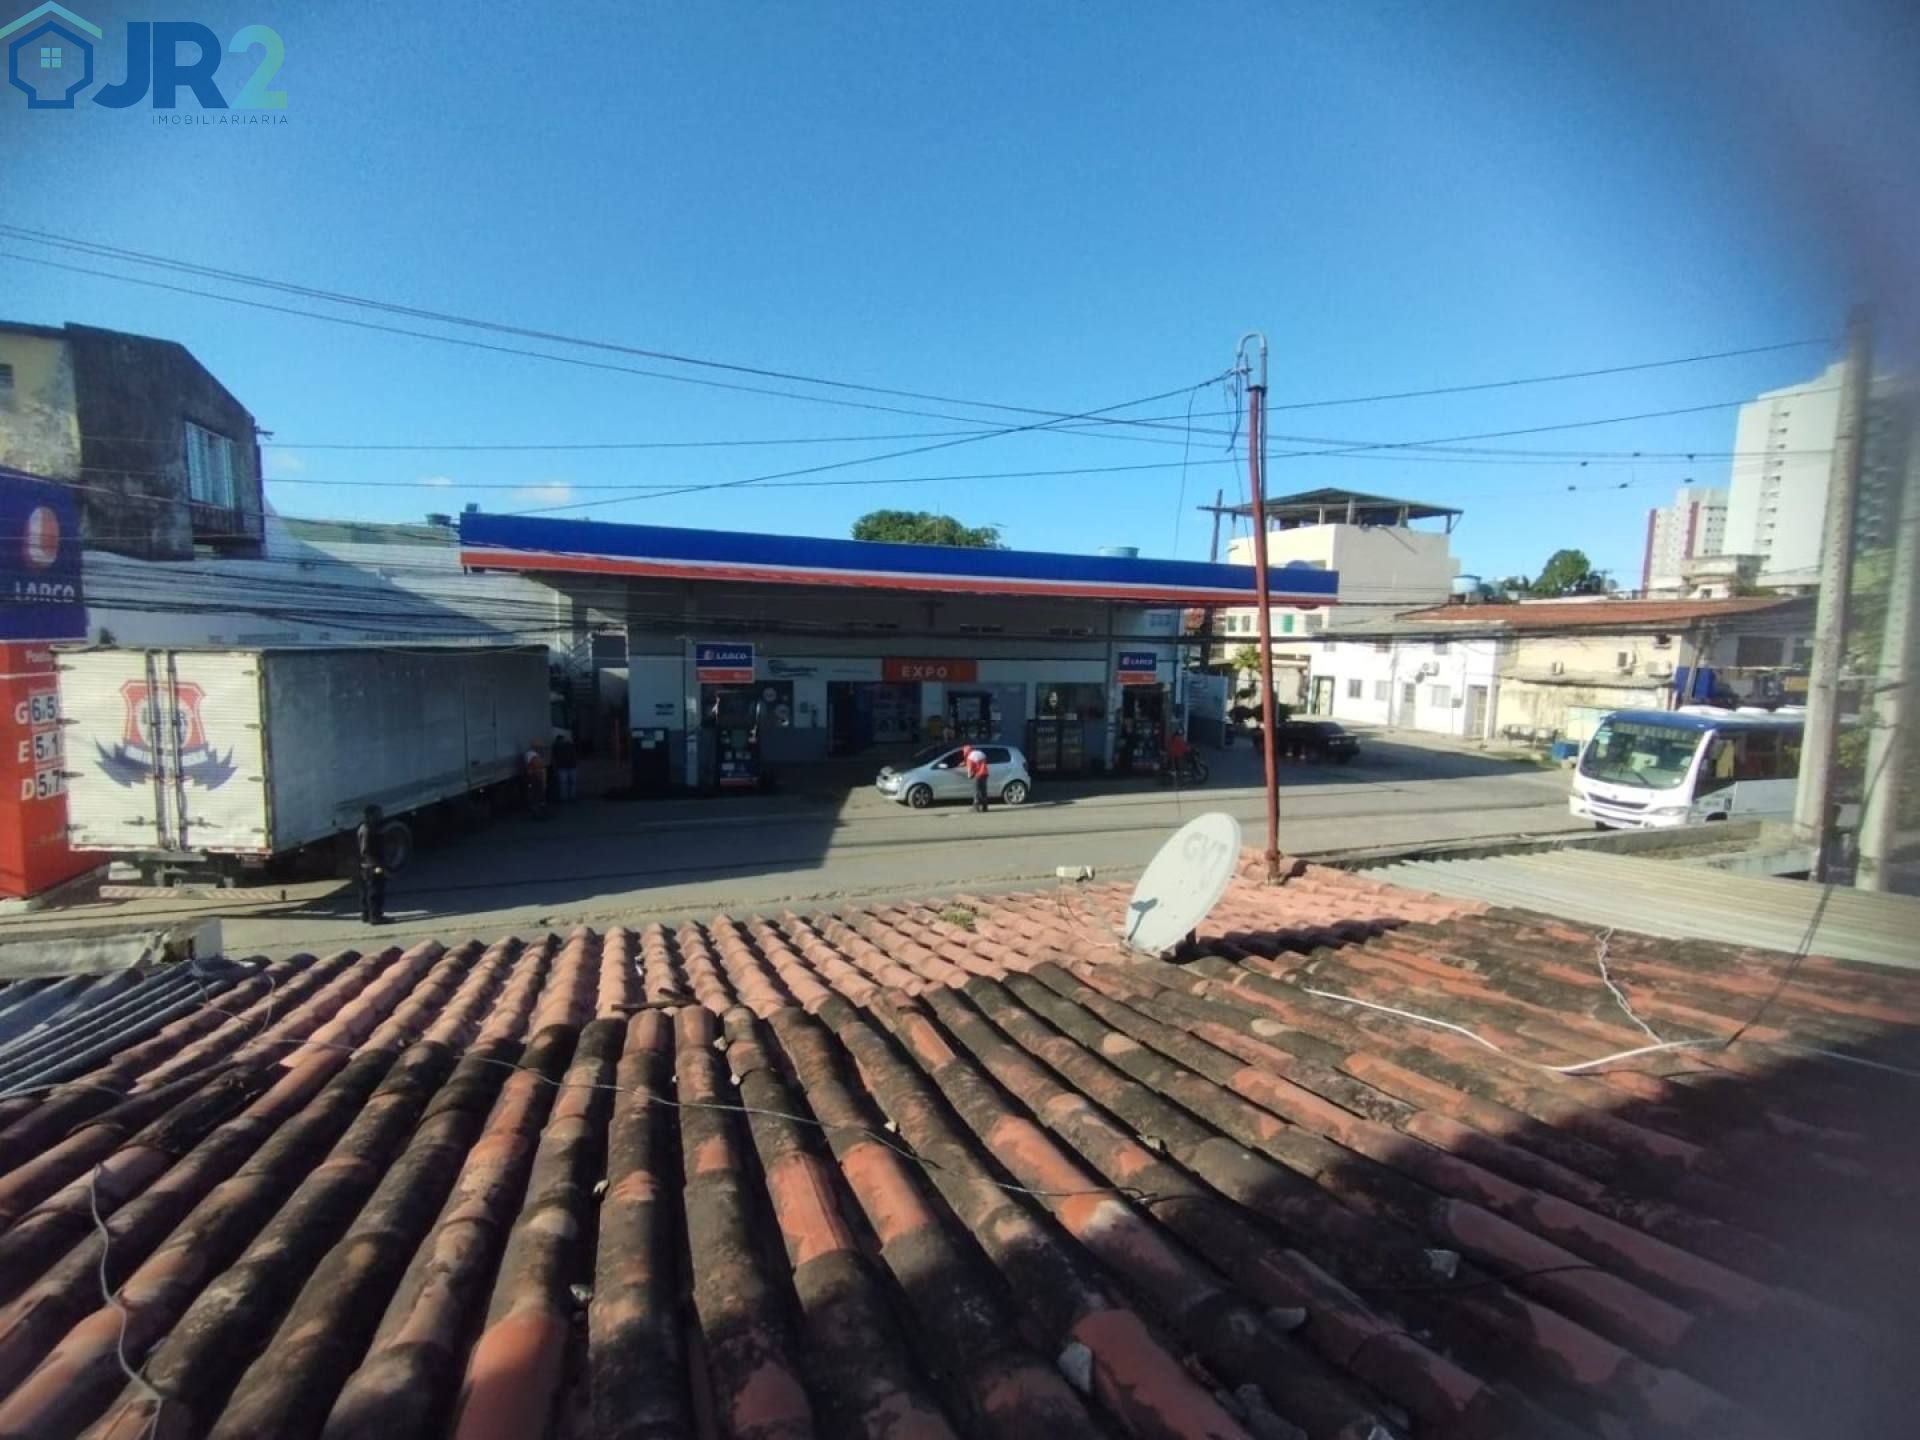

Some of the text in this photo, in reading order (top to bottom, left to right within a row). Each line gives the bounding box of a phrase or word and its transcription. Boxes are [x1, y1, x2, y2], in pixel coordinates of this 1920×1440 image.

[901, 665, 948, 679] EXPO
[15, 700, 29, 725] G
[18, 740, 30, 764] E
[20, 778, 35, 801] D
